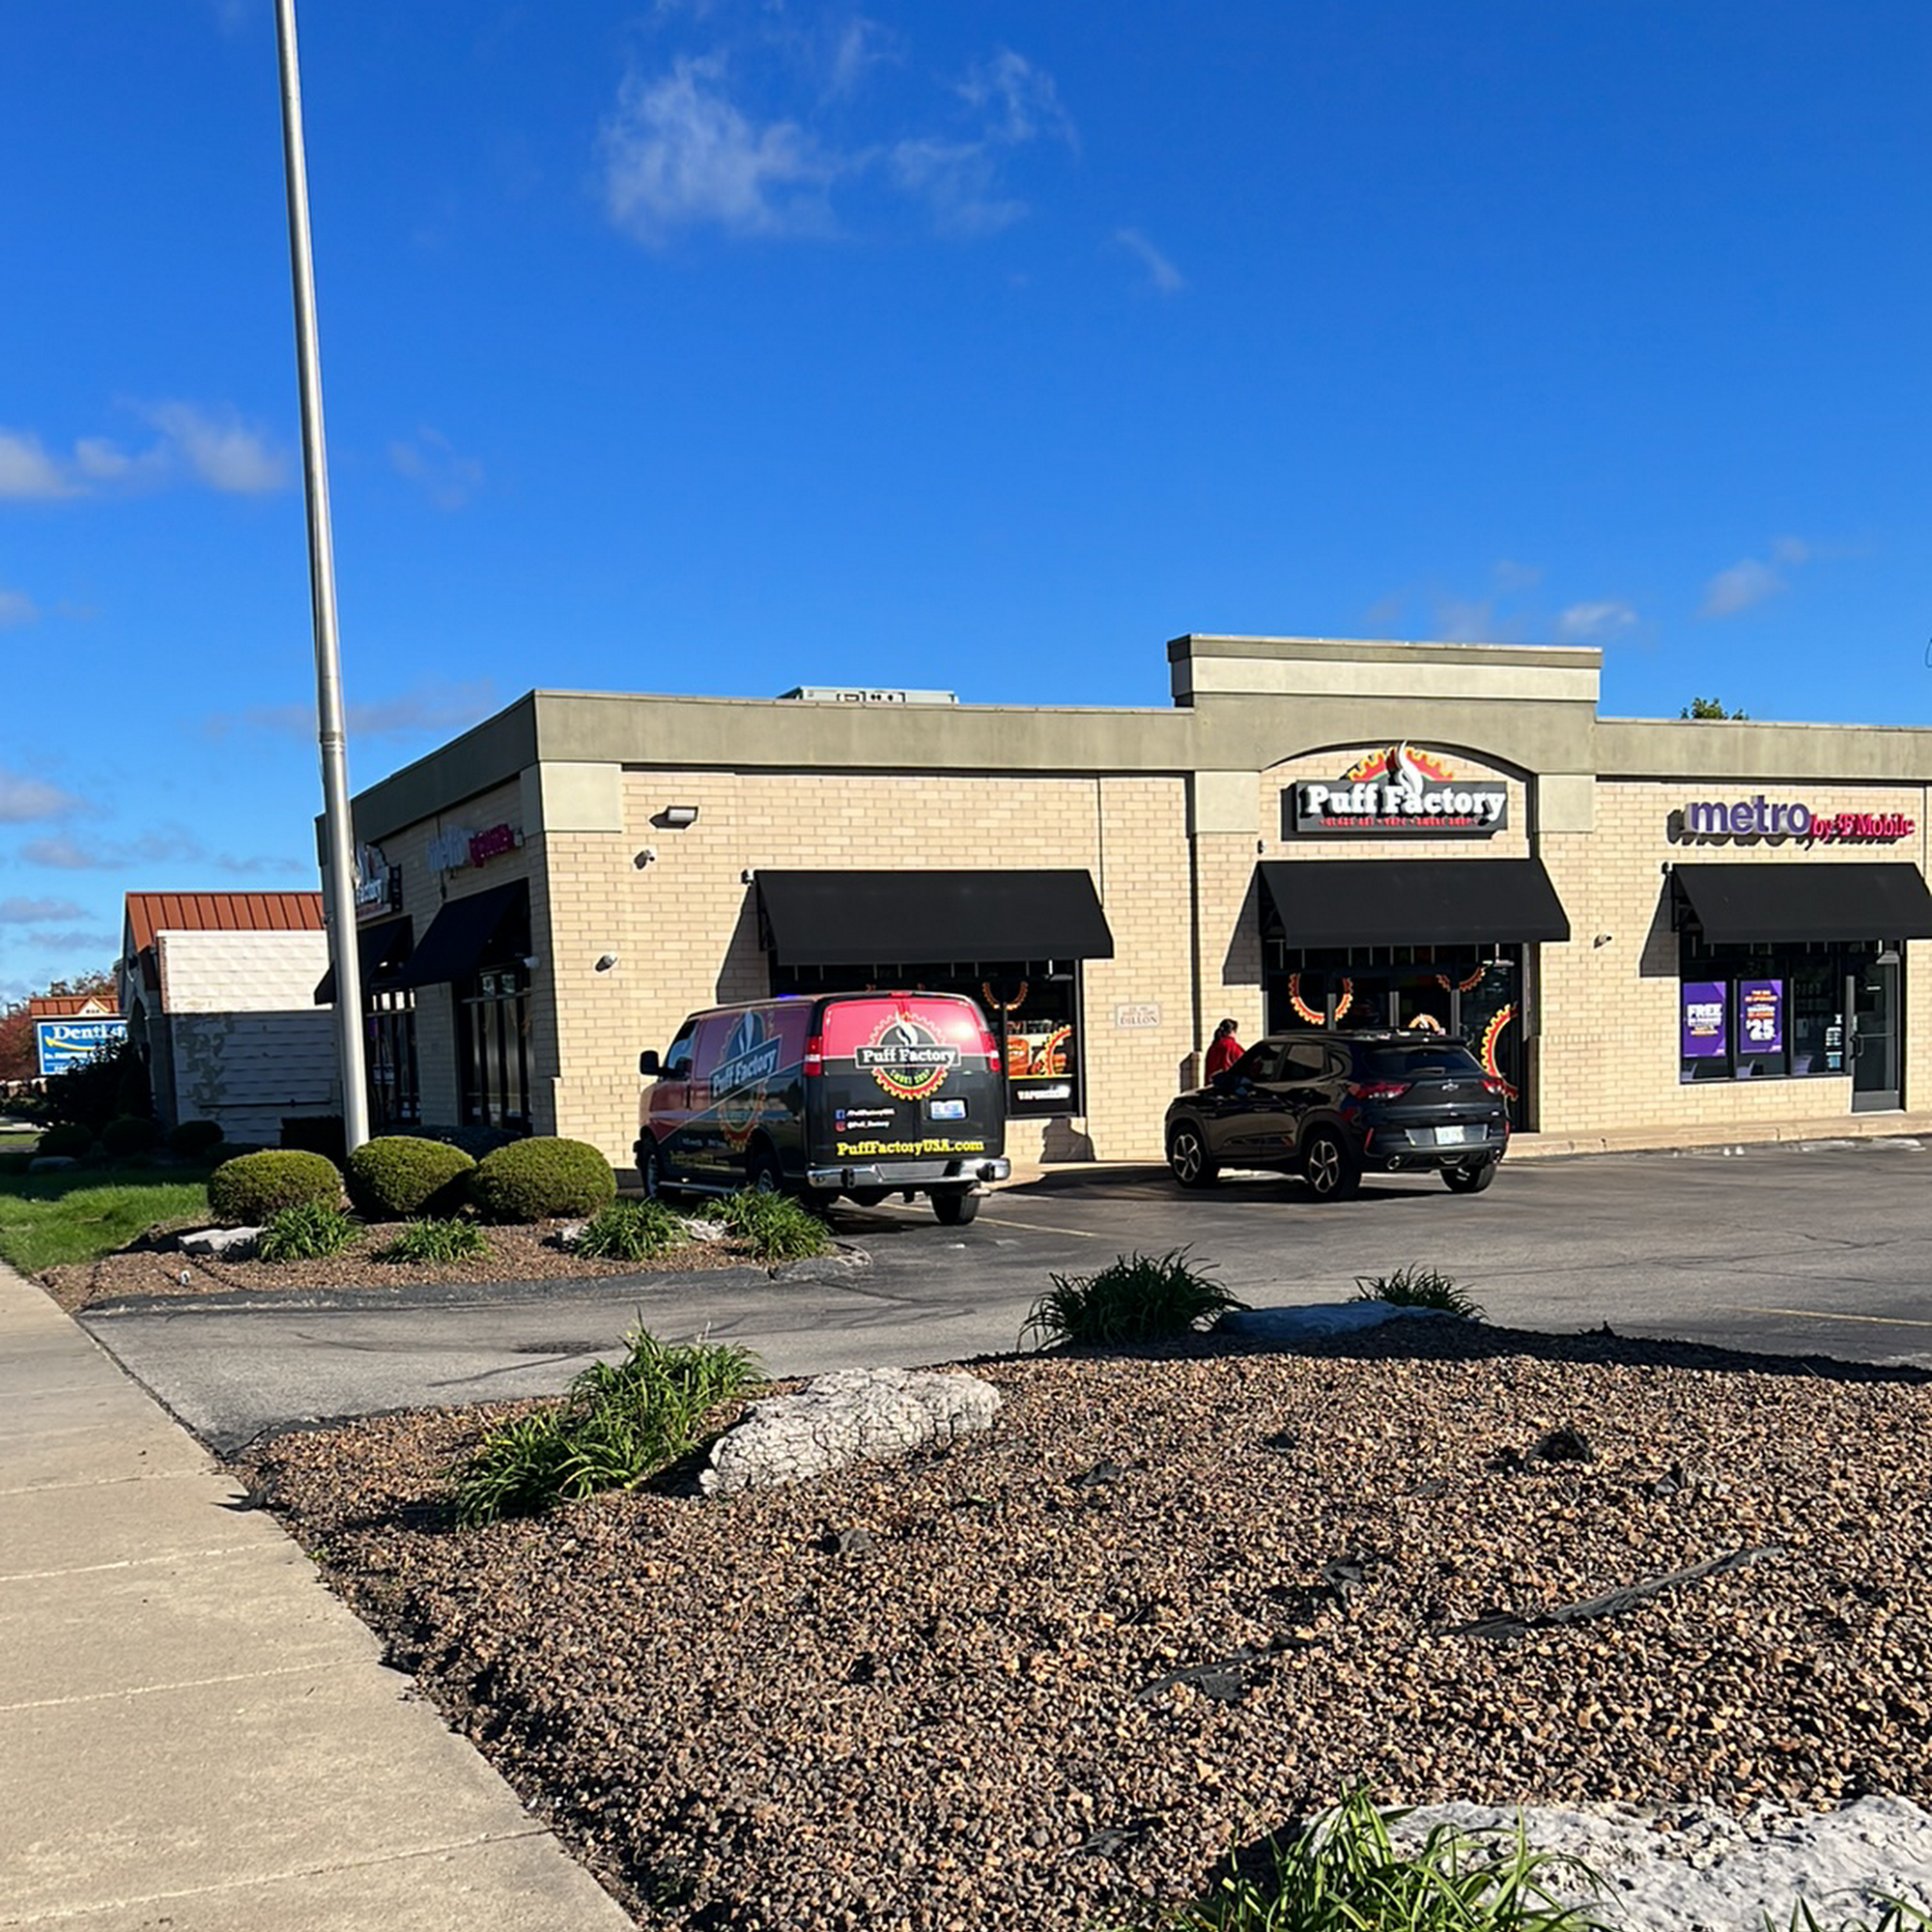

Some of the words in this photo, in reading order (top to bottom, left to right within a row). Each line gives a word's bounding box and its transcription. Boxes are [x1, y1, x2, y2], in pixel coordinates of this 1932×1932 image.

[1307, 783, 1378, 814] Puff
[1383, 785, 1506, 821] Factory
[1688, 795, 1810, 834] metro
[1811, 814, 1833, 840] by
[713, 1065, 734, 1097] Puff
[735, 1049, 777, 1084] Factory
[863, 1048, 896, 1063] Puff
[899, 1048, 955, 1065] Factory
[837, 1139, 984, 1156] PuffFactoryUSA.com
